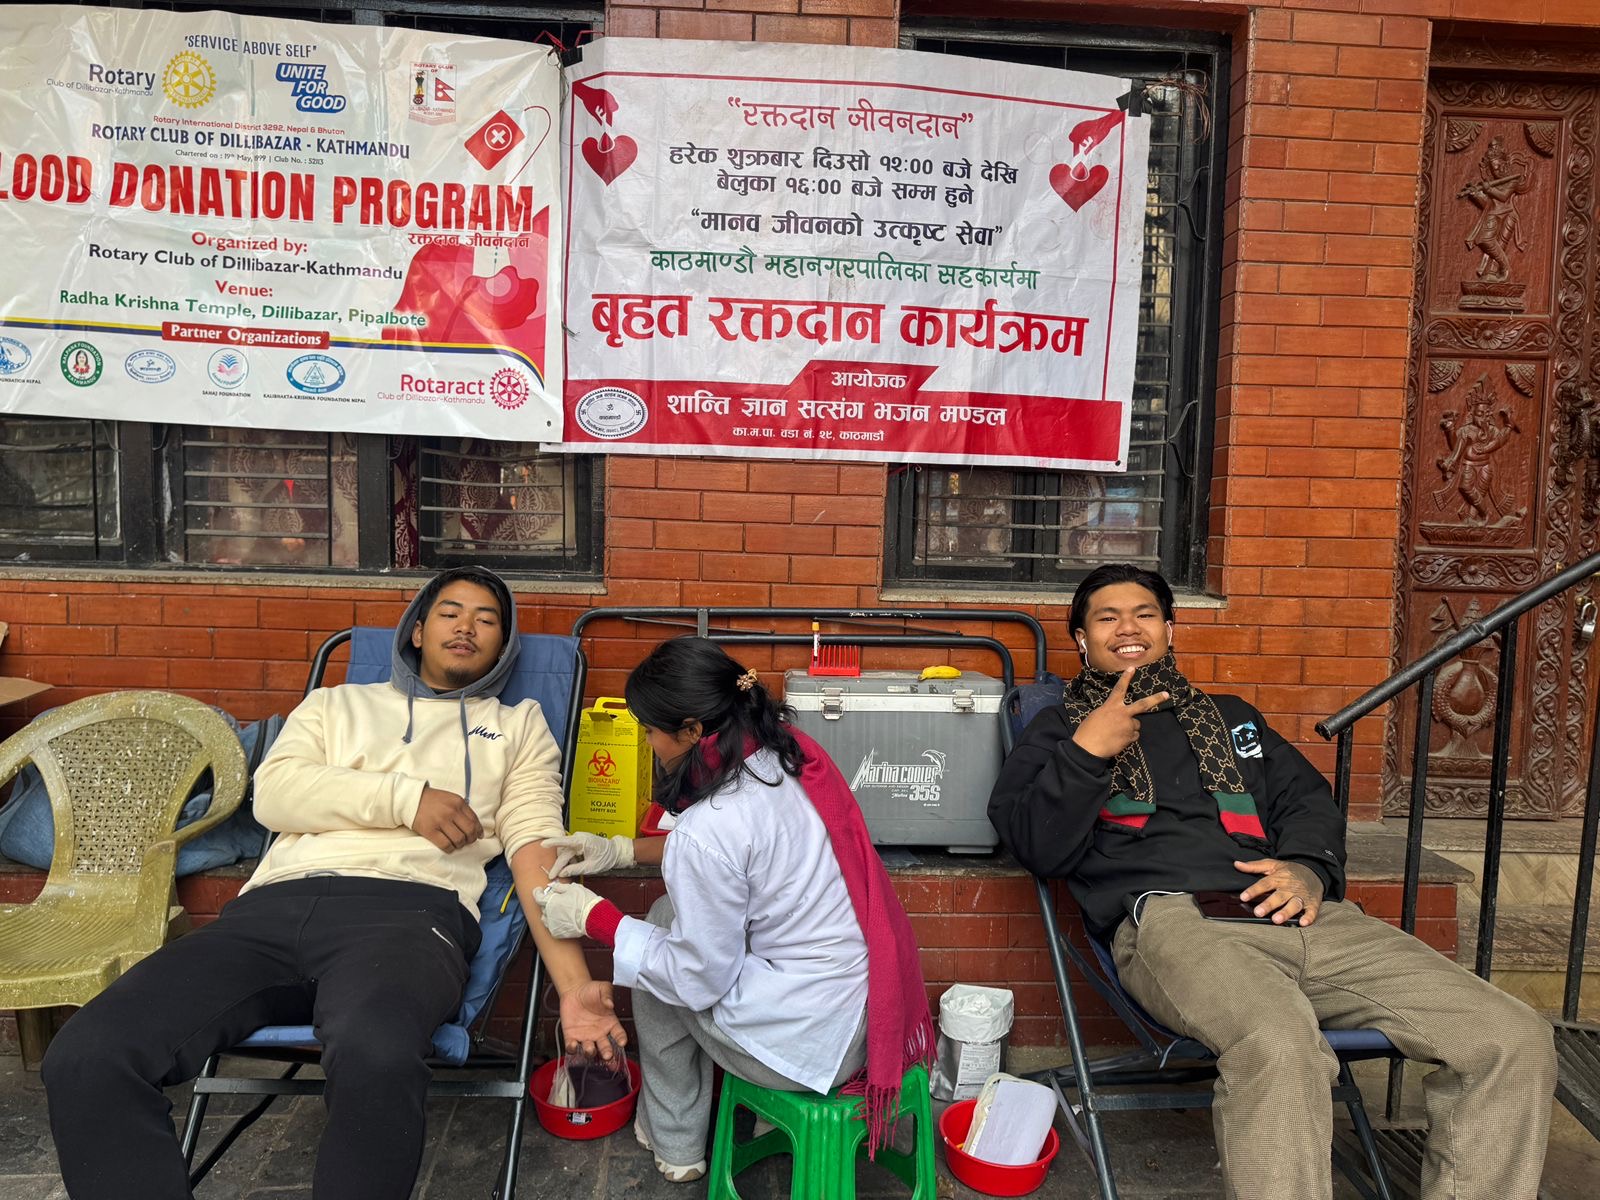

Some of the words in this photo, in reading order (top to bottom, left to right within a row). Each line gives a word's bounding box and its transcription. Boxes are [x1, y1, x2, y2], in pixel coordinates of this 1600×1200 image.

[243, 41, 282, 57] ABOVE
[89, 64, 156, 90] Rotary
[279, 65, 325, 80] UNITE
[46, 78, 65, 88] Club
[66, 81, 75, 89] of
[76, 82, 154, 97] Dillibazar-Kathmandu
[297, 81, 327, 95] FOR
[300, 95, 345, 110] GOOD
[153, 116, 180, 126] Rotary
[181, 118, 233, 129] International
[234, 122, 261, 131] District
[287, 125, 309, 134] Nepal
[317, 126, 345, 135] Bhutan
[91, 123, 146, 141] ROTARY
[150, 127, 189, 144] CLUB
[194, 131, 215, 146] OF
[220, 133, 302, 151] DILLIBAZAR
[316, 139, 410, 159] KATHMANDU
[175, 149, 208, 158] Chartered
[291, 156, 303, 164] No.
[669, 142, 719, 165] हरेक
[727, 148, 804, 170] शुक्रबार
[812, 146, 871, 171] दिउसो
[943, 158, 972, 179] बजे
[980, 160, 1019, 184] देखि
[109, 162, 315, 221] DONATION
[333, 175, 534, 232] PROGRAM
[717, 168, 776, 196] बेलुका
[851, 176, 883, 198] बजे
[891, 183, 937, 201] सम्म
[945, 183, 974, 208] हुने
[691, 208, 761, 232] “मानव
[771, 210, 864, 237] जीवनको
[873, 220, 947, 246] उत्कृष्ट
[956, 220, 1003, 246] सेवा”
[191, 231, 278, 251] Organized
[283, 238, 308, 259] by:
[408, 233, 460, 247] रक्तदान
[466, 232, 529, 248] जीवनदान
[89, 243, 148, 265] Rotary
[154, 250, 195, 266] Club
[200, 255, 217, 268] of
[222, 256, 403, 280] Dillibazar-Kathmandu
[650, 245, 757, 274] काठमाण्डौ
[764, 251, 931, 283] महानगरपालिका
[938, 261, 1041, 290] सहकार्यमा
[215, 280, 273, 297] Venue:
[60, 290, 109, 306] Radha
[114, 294, 180, 312] Krishna
[185, 299, 256, 319] Temple,
[261, 305, 342, 323] Dillibazar,
[348, 308, 427, 326] Pipalbote
[171, 324, 222, 340] Partner
[227, 329, 321, 345] Organizations
[591, 293, 693, 348] बृहत
[708, 296, 886, 346] रक्तदान
[900, 298, 1090, 357] कार्यक्रम
[401, 374, 485, 395] Rotaract
[831, 368, 907, 389] आयोजक
[377, 391, 395, 400] Club
[396, 393, 404, 401] of
[405, 393, 486, 404] Dillibazar-Kathmandu
[667, 389, 732, 415] शान्ति
[741, 397, 788, 418] ज्ञान
[797, 397, 865, 421] सत्संग
[873, 402, 931, 423] भजन
[940, 405, 1007, 426] मण्डल
[780, 428, 800, 438] वडा
[849, 747, 900, 792] Marina
[900, 764, 940, 785] cooler
[588, 777, 620, 785] BIOHAZARD
[909, 784, 941, 801] 35S
[590, 800, 617, 808] KOJAK
